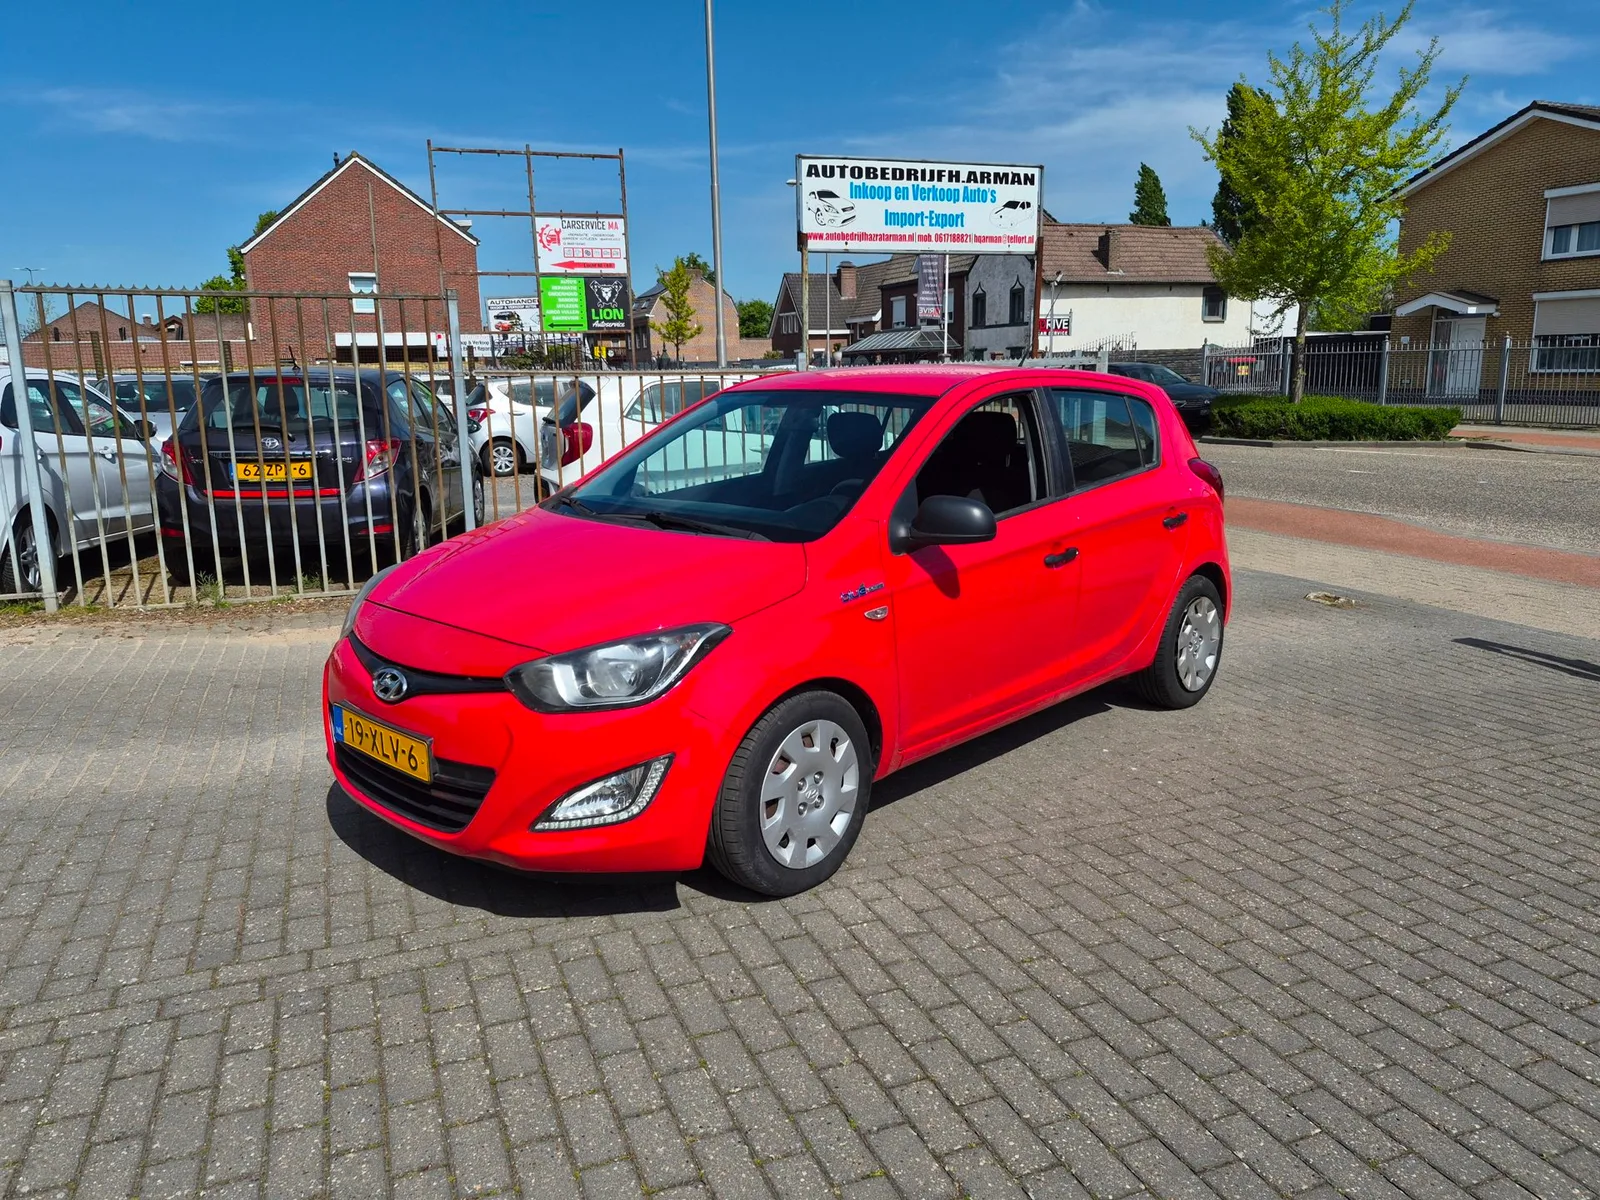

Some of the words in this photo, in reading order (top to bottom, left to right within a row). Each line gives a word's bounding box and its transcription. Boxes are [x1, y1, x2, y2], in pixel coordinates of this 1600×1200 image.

[806, 163, 1035, 186] AUTOBEDRIJFH.ARMAN
[850, 182, 892, 202] Inkoop
[894, 186, 910, 201] en
[911, 184, 960, 204] Verkoop
[962, 187, 997, 204] Auto's
[561, 219, 606, 230] CARSERVICE
[884, 208, 965, 229] Import-Export
[591, 308, 624, 320] LION
[592, 320, 626, 328] Autoservice
[243, 464, 307, 477] 62ZP-6
[348, 717, 419, 772] 19-XLV-6
